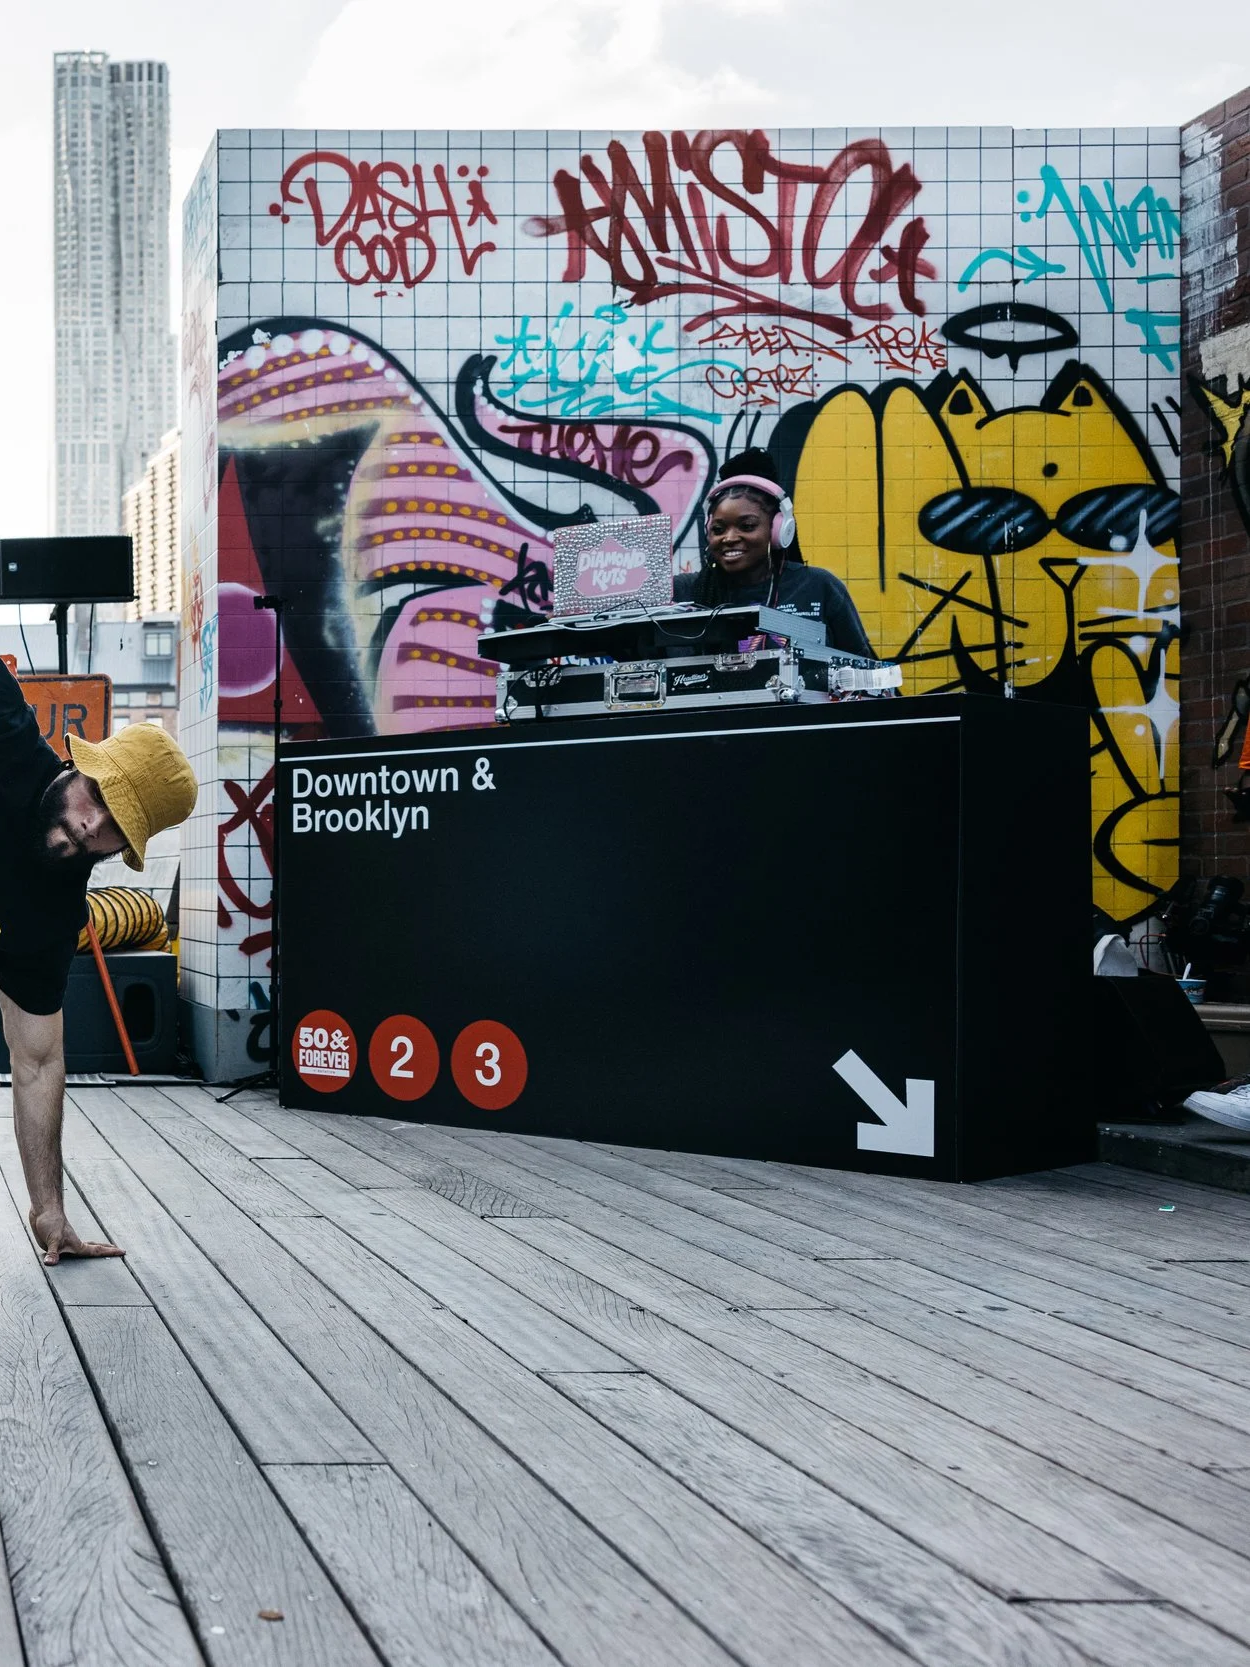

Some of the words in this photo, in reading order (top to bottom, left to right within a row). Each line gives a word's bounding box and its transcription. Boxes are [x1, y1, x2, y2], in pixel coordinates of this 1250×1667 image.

[292, 764, 459, 799] Downtown
[471, 756, 497, 791] &
[292, 799, 430, 839] Brooklyn
[298, 1048, 350, 1071] FOREVER
[390, 1035, 415, 1079] 2
[474, 1041, 502, 1087] 3
